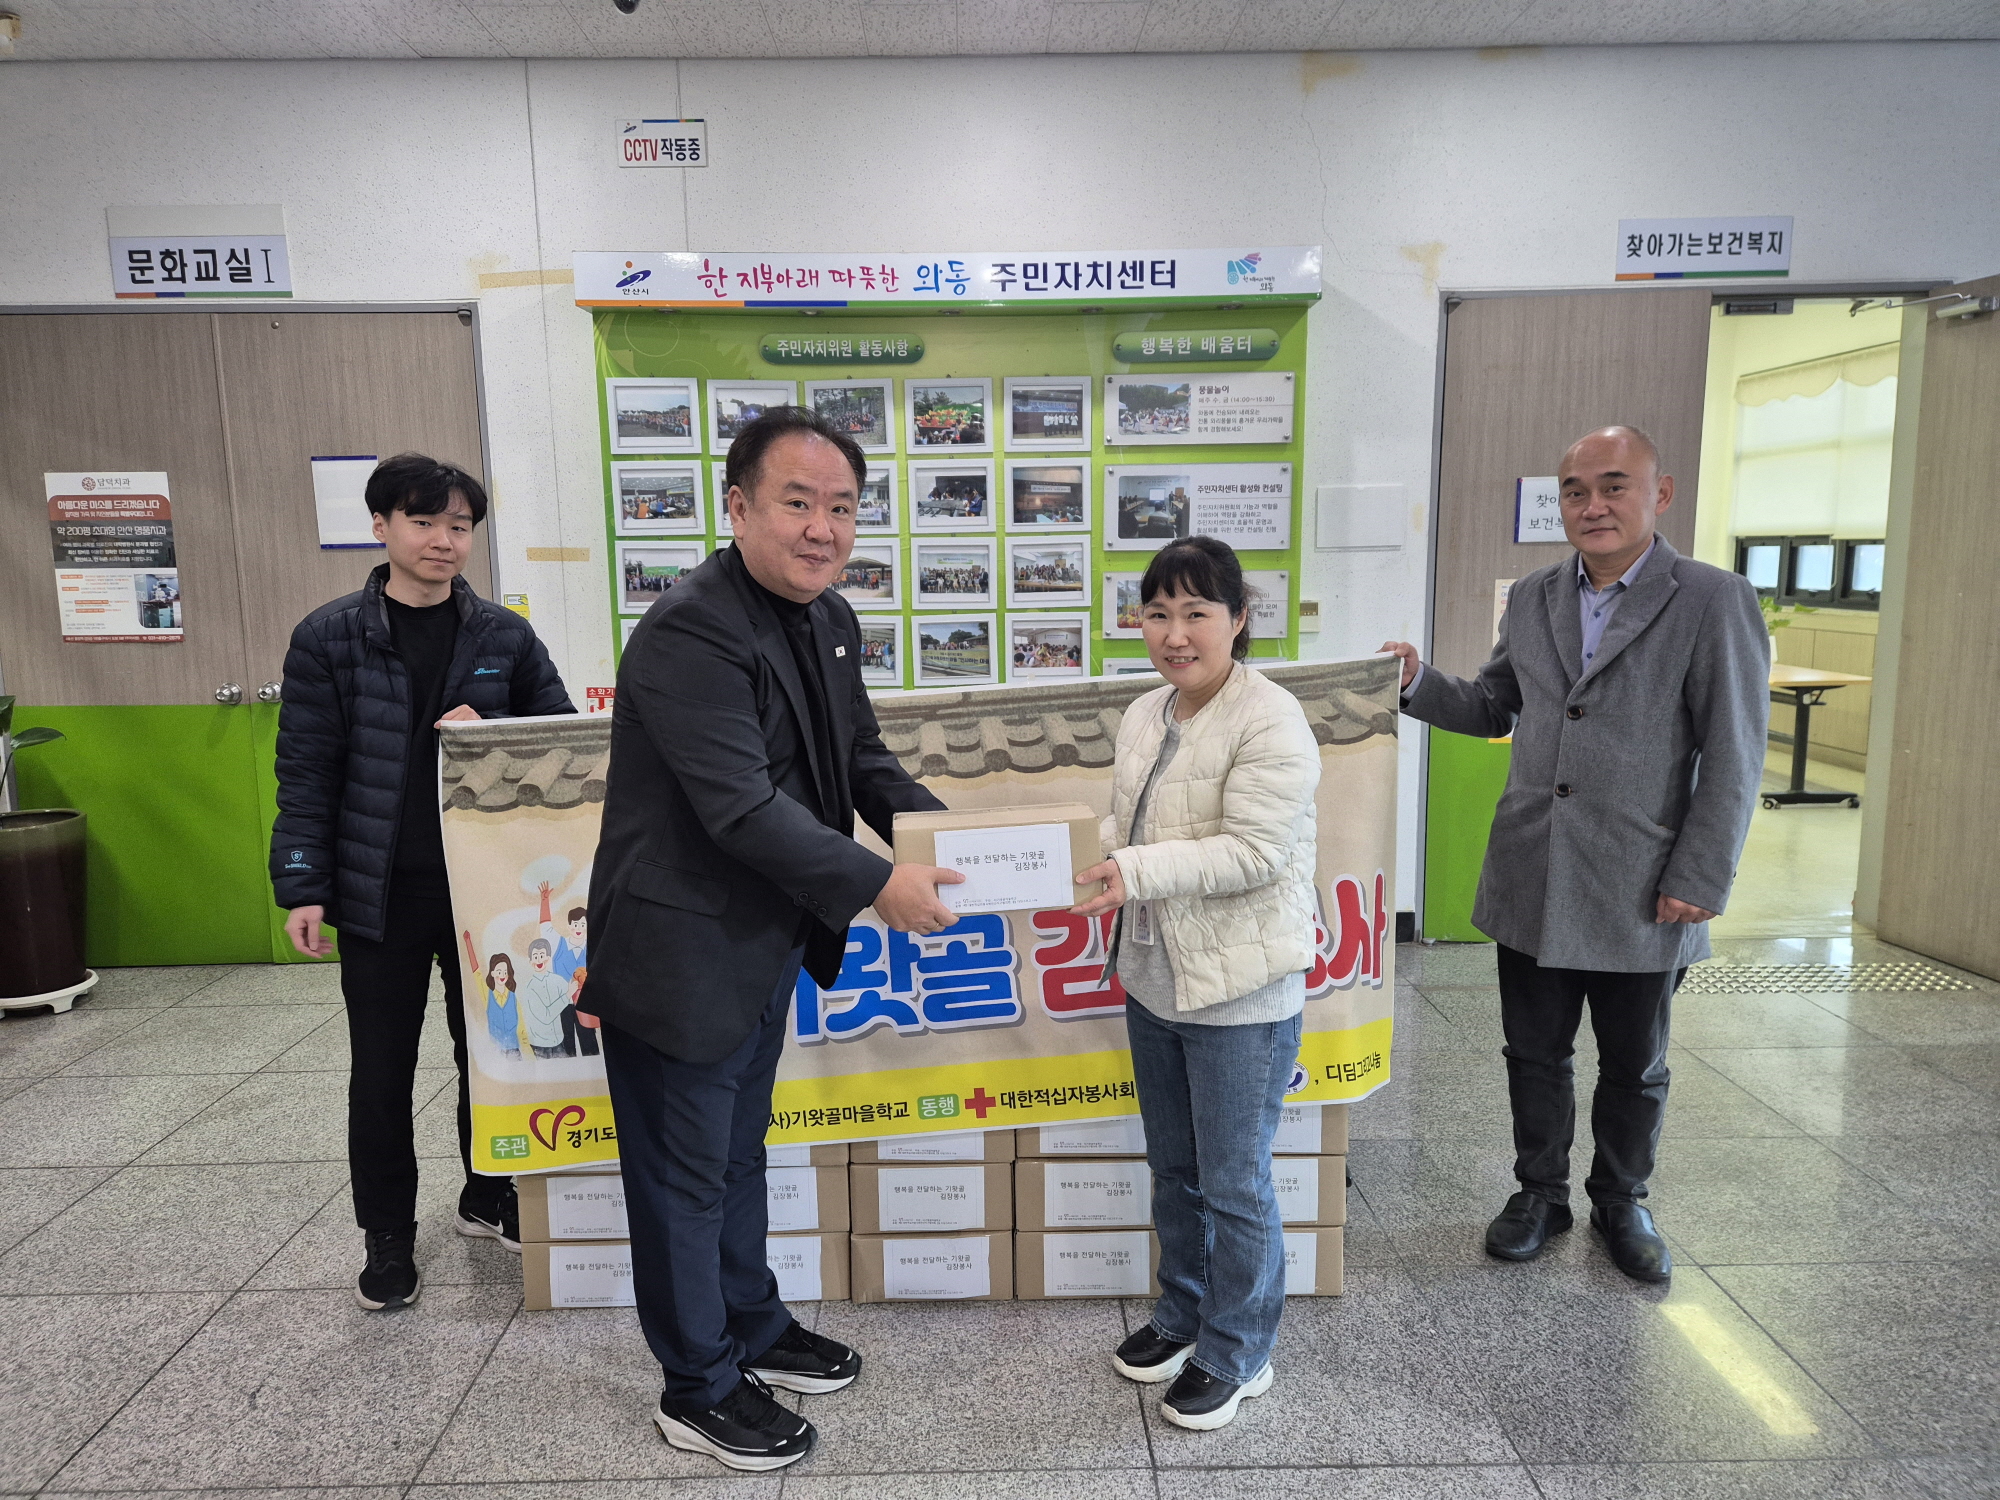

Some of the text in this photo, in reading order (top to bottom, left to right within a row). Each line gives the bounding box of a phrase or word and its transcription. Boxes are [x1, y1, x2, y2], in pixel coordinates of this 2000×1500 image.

[1626, 231, 1783, 258] 찾아가는보건복지
[128, 248, 252, 284] 문화교실
[696, 258, 1176, 297] 한 지붕아래 따뜻한 와동 주민자치센터
[621, 287, 650, 296] 안산시
[776, 339, 909, 358] 주민자치위원 활동사항
[1140, 335, 1252, 355] 행복한 배움터
[1199, 385, 1230, 395] 풍물놀이
[1197, 483, 1283, 494] 주민자치센터 활성화 컨설팅
[57, 499, 160, 510] 아름다운 미소를 드리겠습니다
[117, 526, 133, 535] 안산
[588, 688, 615, 696] 소화기
[955, 850, 1045, 866] 행복을 전달하는 기왓골
[1014, 861, 1047, 872] 김장봉사
[797, 914, 1017, 1035] 왓골
[921, 1096, 955, 1117] 동행
[495, 1137, 527, 1157] 주관
[1082, 1181, 1109, 1189] 전달하는
[1111, 1181, 1131, 1189] 기왓골
[1278, 1177, 1298, 1185] 기왓골
[778, 1184, 798, 1192] 기왓골
[894, 1186, 914, 1194] 행복을
[916, 1185, 943, 1193] 전달하는
[563, 1193, 584, 1201] 행복을
[587, 1192, 614, 1200] 전달하는
[773, 1192, 799, 1200] 김장봉사
[1106, 1189, 1132, 1197] 김장봉사
[782, 1253, 802, 1262] 기왓골
[1081, 1251, 1107, 1259] 전달하는
[1110, 1250, 1130, 1258] 기왓골
[900, 1254, 971, 1265] 행복을 전달하는 기왓골
[1105, 1258, 1131, 1266] 김장봉사
[565, 1263, 586, 1271] 행복을
[588, 1262, 615, 1271] 전달하는
[778, 1262, 804, 1270] 김장봉사
[946, 1263, 972, 1271] 김장봉사
